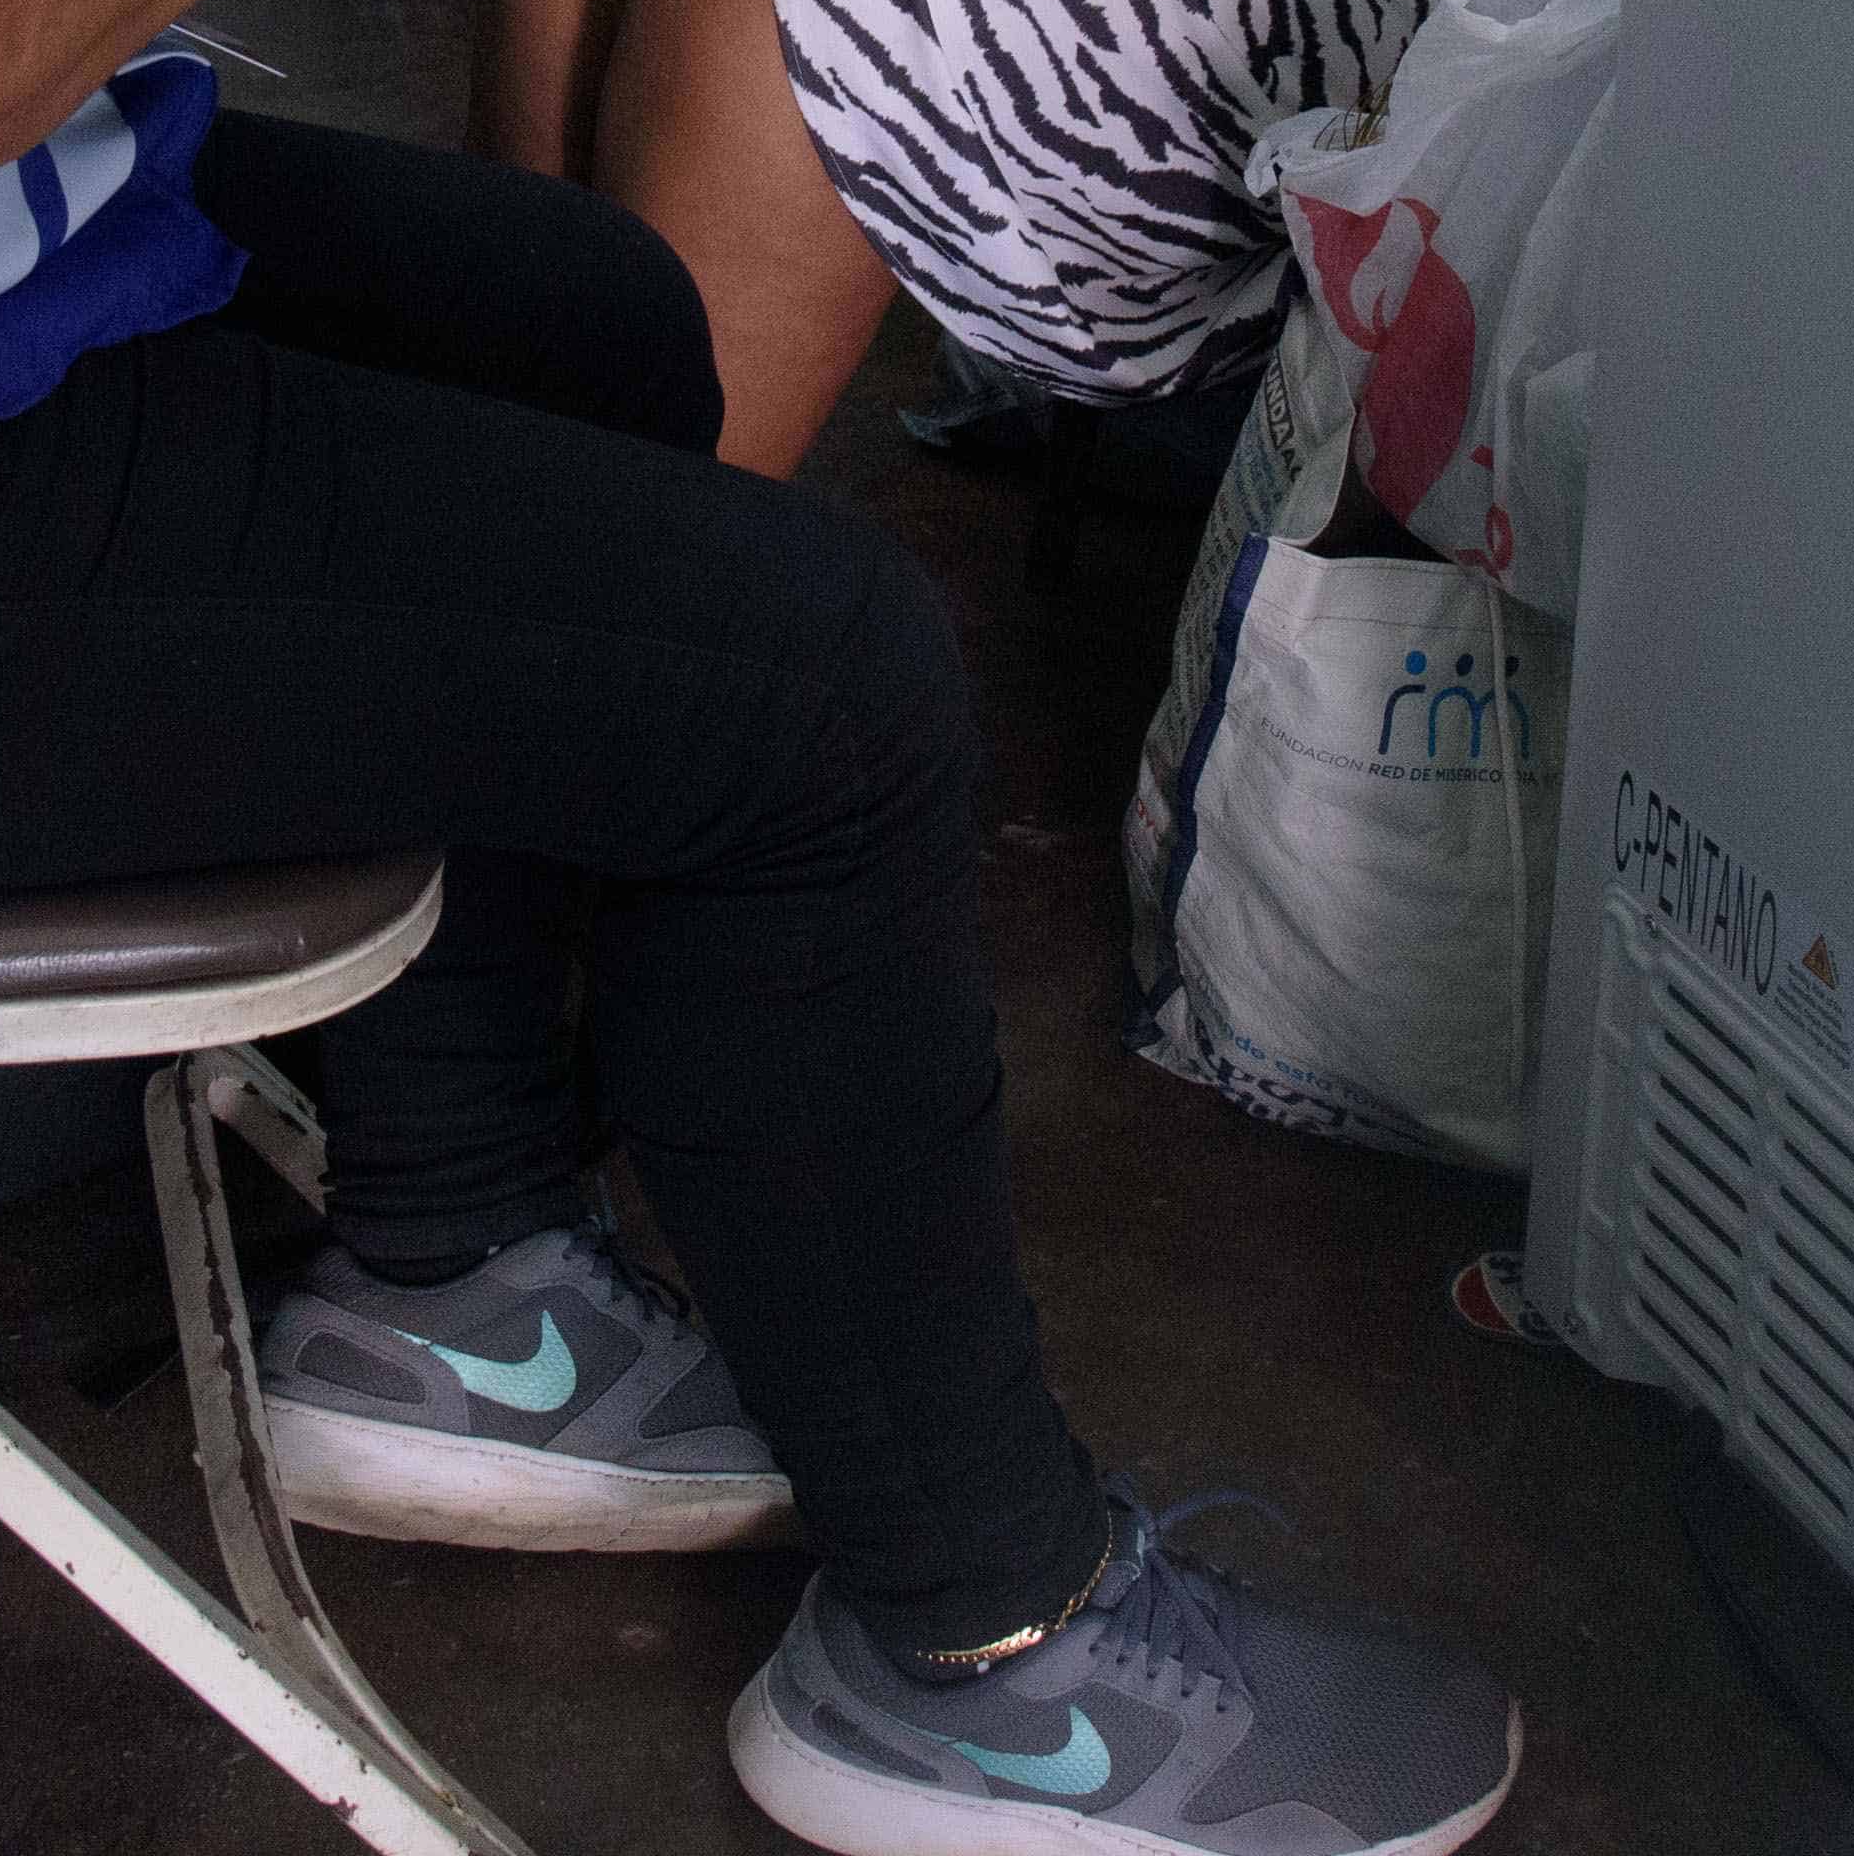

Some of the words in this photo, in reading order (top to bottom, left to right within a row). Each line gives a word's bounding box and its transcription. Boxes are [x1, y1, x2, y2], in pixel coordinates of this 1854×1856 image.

[1368, 762, 1406, 780] RED
[1410, 767, 1432, 782] DE
[1612, 769, 1778, 996] C-PENTANO
